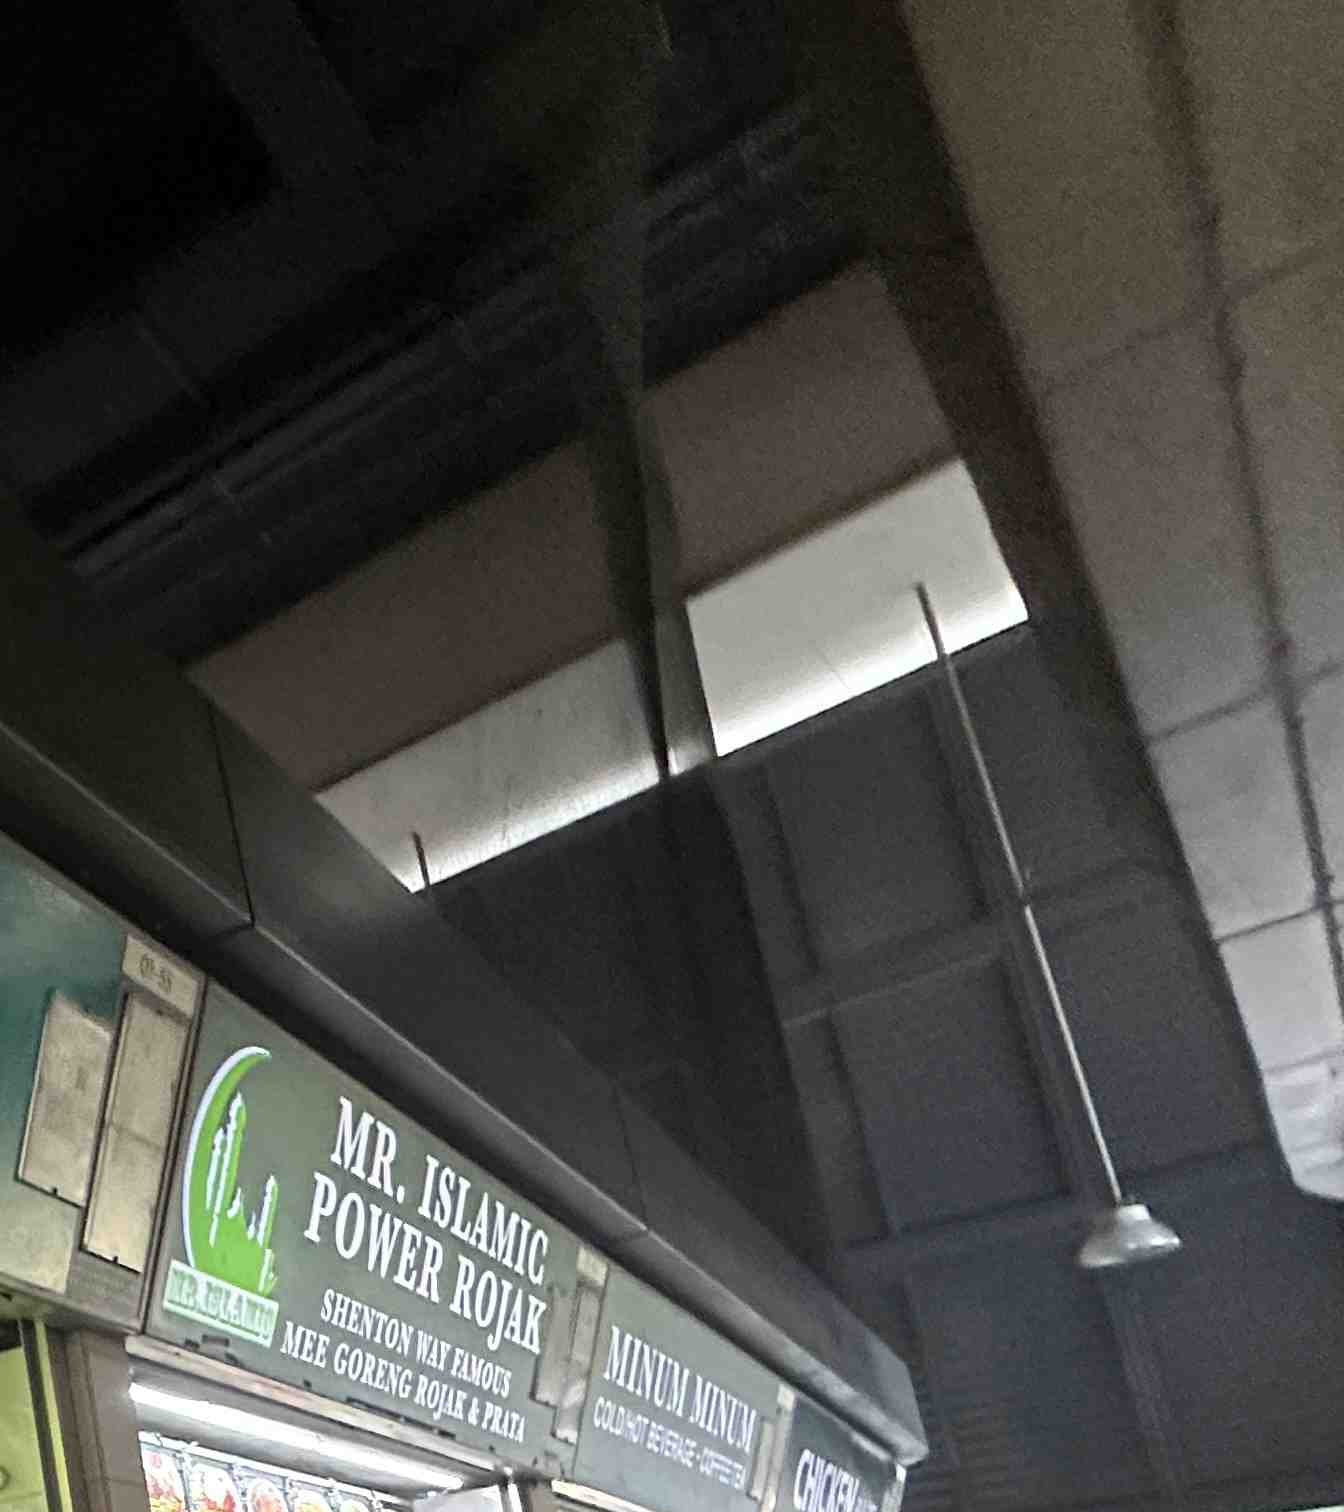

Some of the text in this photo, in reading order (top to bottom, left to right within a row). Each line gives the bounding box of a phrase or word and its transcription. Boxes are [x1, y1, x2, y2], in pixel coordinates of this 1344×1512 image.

[330, 1096, 549, 1286] MR. ISLAMIC
[303, 1171, 547, 1355] POWER ROJAK
[280, 1320, 526, 1443] MEE GORENG ROJAK & PRATA
[320, 1288, 513, 1399] SHENTON WAY FAMOUS
[603, 1325, 758, 1453] MINUM MINUM
